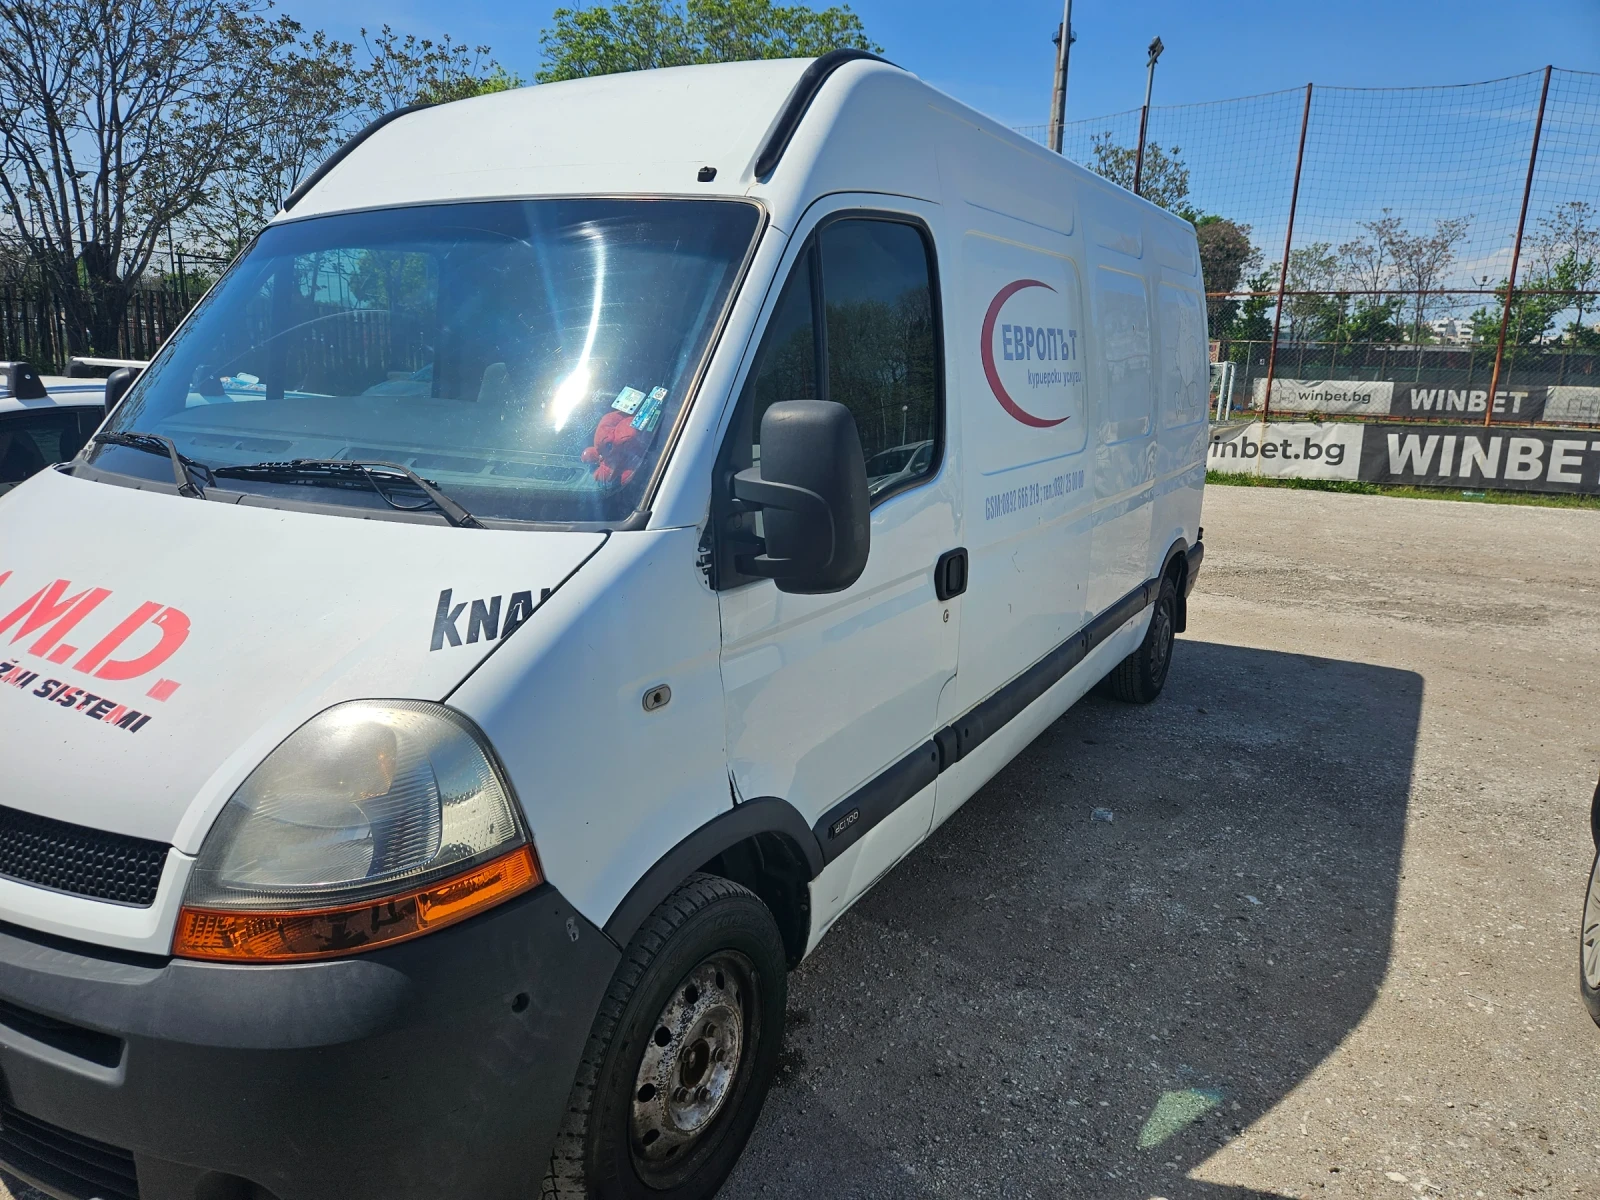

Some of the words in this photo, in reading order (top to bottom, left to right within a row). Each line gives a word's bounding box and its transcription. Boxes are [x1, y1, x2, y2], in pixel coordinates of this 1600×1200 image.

[1002, 324, 1077, 361] ЕВРОПЪТ
[1298, 389, 1371, 405] winbet.bg
[1411, 388, 1529, 414] WINBET
[1209, 435, 1345, 466] inbet.bg
[1387, 433, 1600, 485] WINBE
[33, 679, 153, 734] SISTEMI
